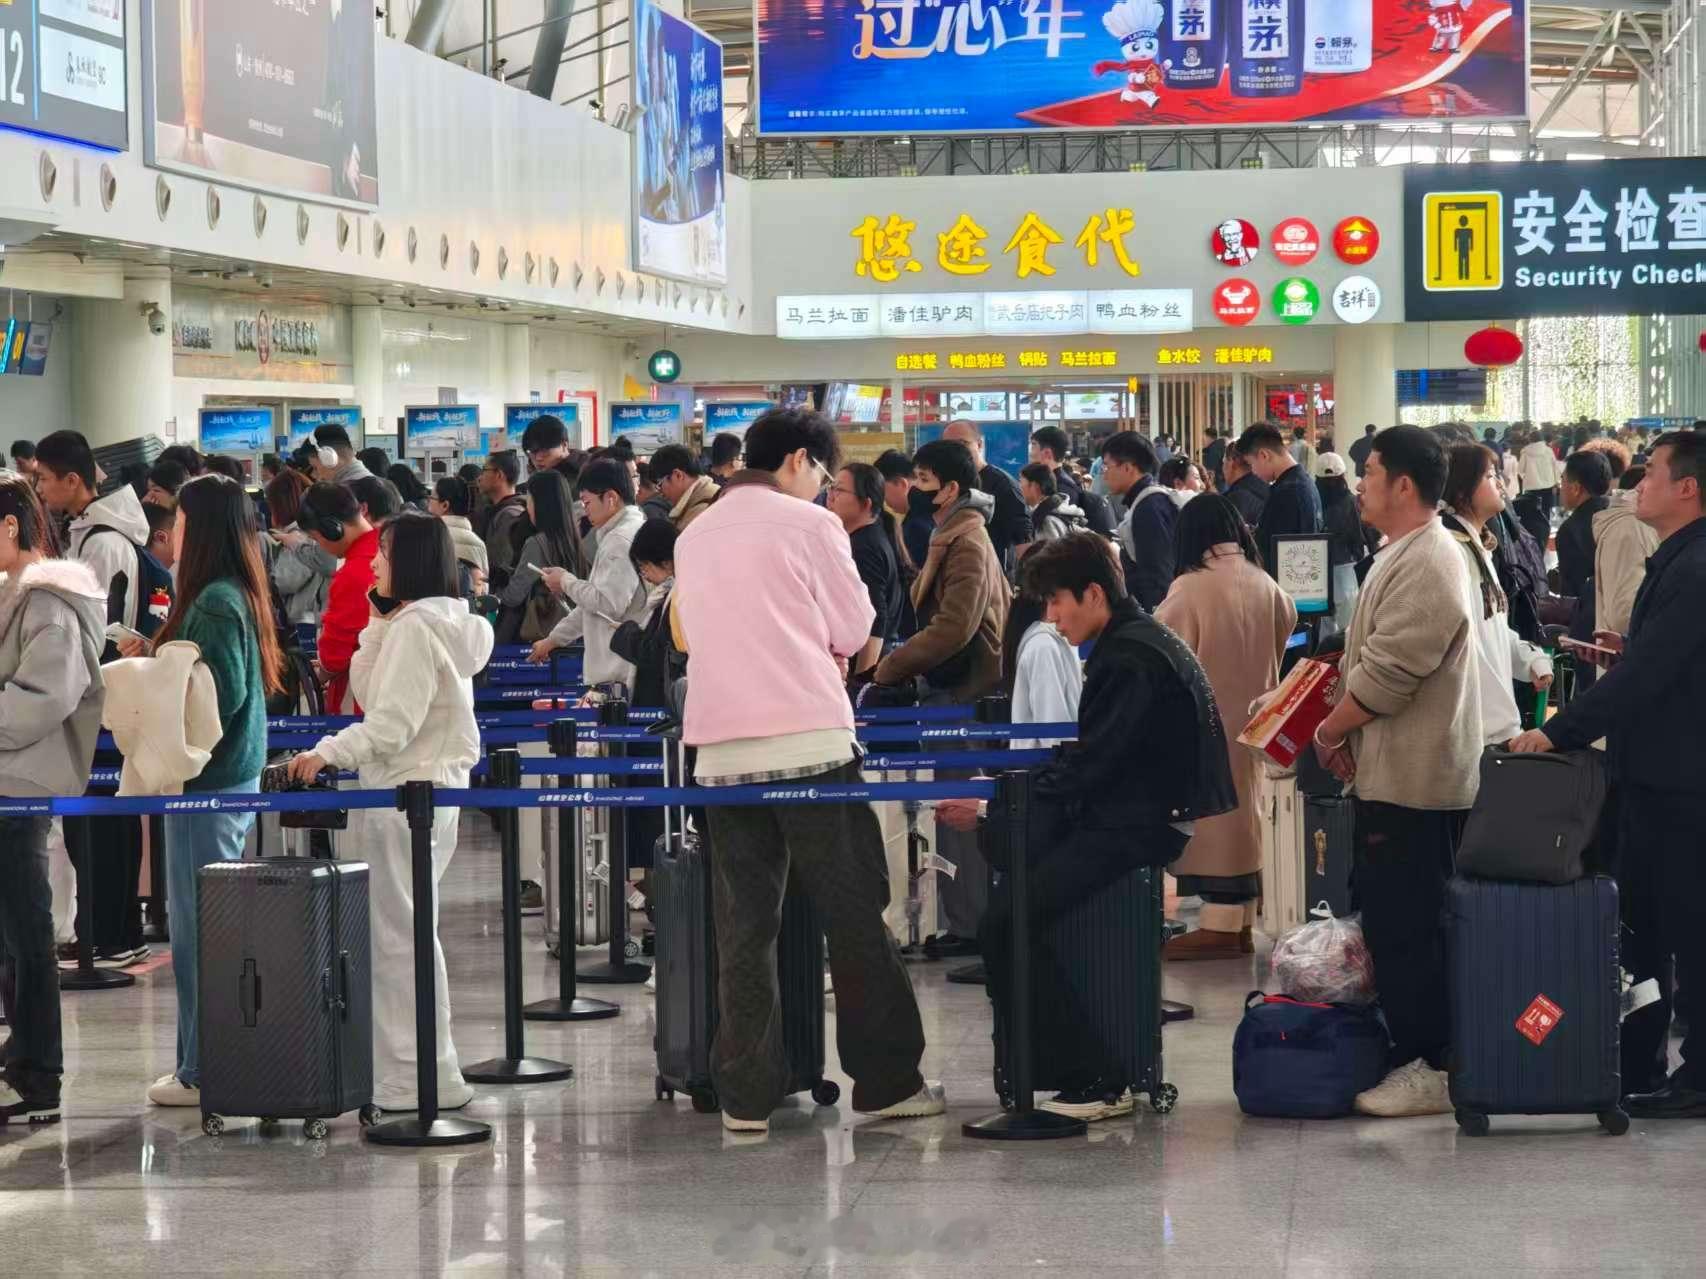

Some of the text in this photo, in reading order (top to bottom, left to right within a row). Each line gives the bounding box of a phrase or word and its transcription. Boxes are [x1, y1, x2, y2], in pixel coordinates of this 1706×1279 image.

[1511, 186, 1706, 256] 安全检查
[850, 208, 1142, 281] 悠途食代
[1515, 265, 1622, 289] Security
[786, 306, 870, 324] 马兰拉面
[887, 304, 974, 323] 潘佳驴肉
[1096, 301, 1183, 319] 鸭血粉丝
[1061, 351, 1117, 367] 马兰拉面
